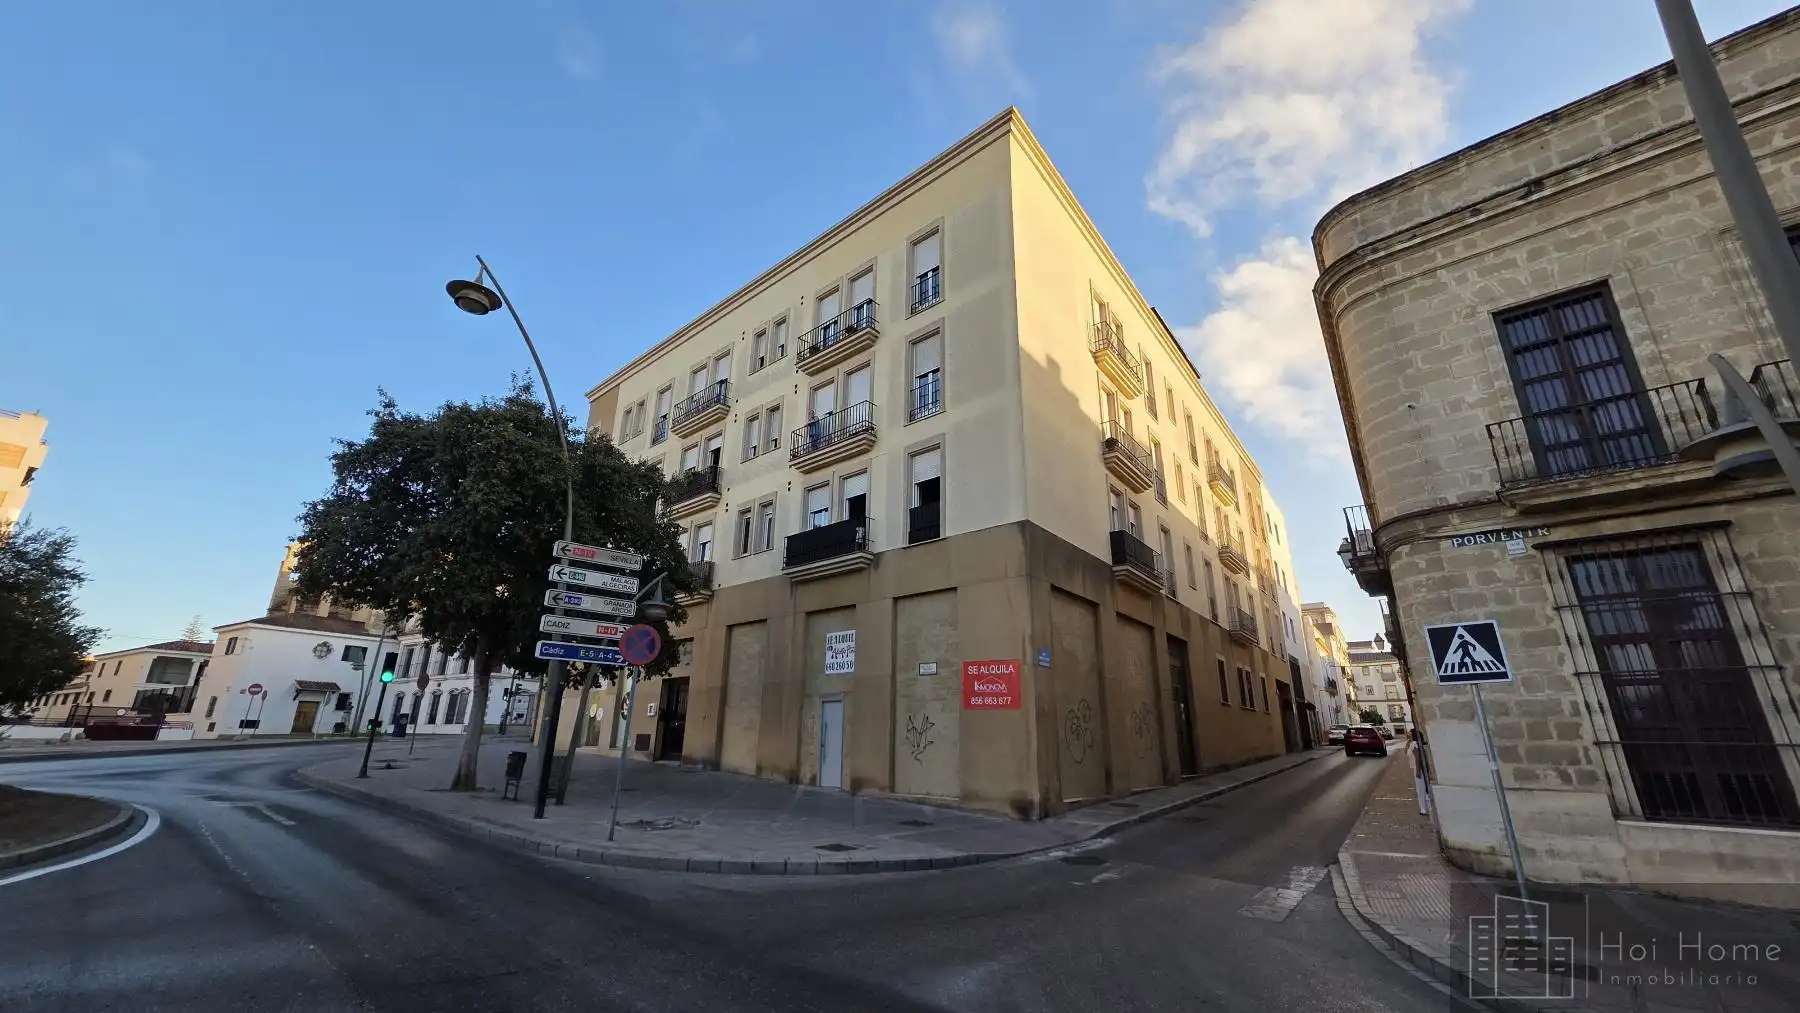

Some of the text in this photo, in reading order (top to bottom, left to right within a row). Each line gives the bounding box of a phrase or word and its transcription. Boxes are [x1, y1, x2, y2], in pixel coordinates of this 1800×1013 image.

[1452, 527, 1550, 548] PORVENIR
[610, 554, 639, 566] SEVILLA
[601, 580, 635, 592] ALGECIRAS
[603, 599, 633, 610] GRANADA
[611, 606, 633, 615] ARCOS
[598, 626, 617, 635] N-IV
[580, 649, 594, 658] E-5
[598, 651, 612, 659] A-4
[967, 664, 1015, 675] SE ALQUILA
[970, 696, 984, 705] 856
[984, 696, 998, 705] 663
